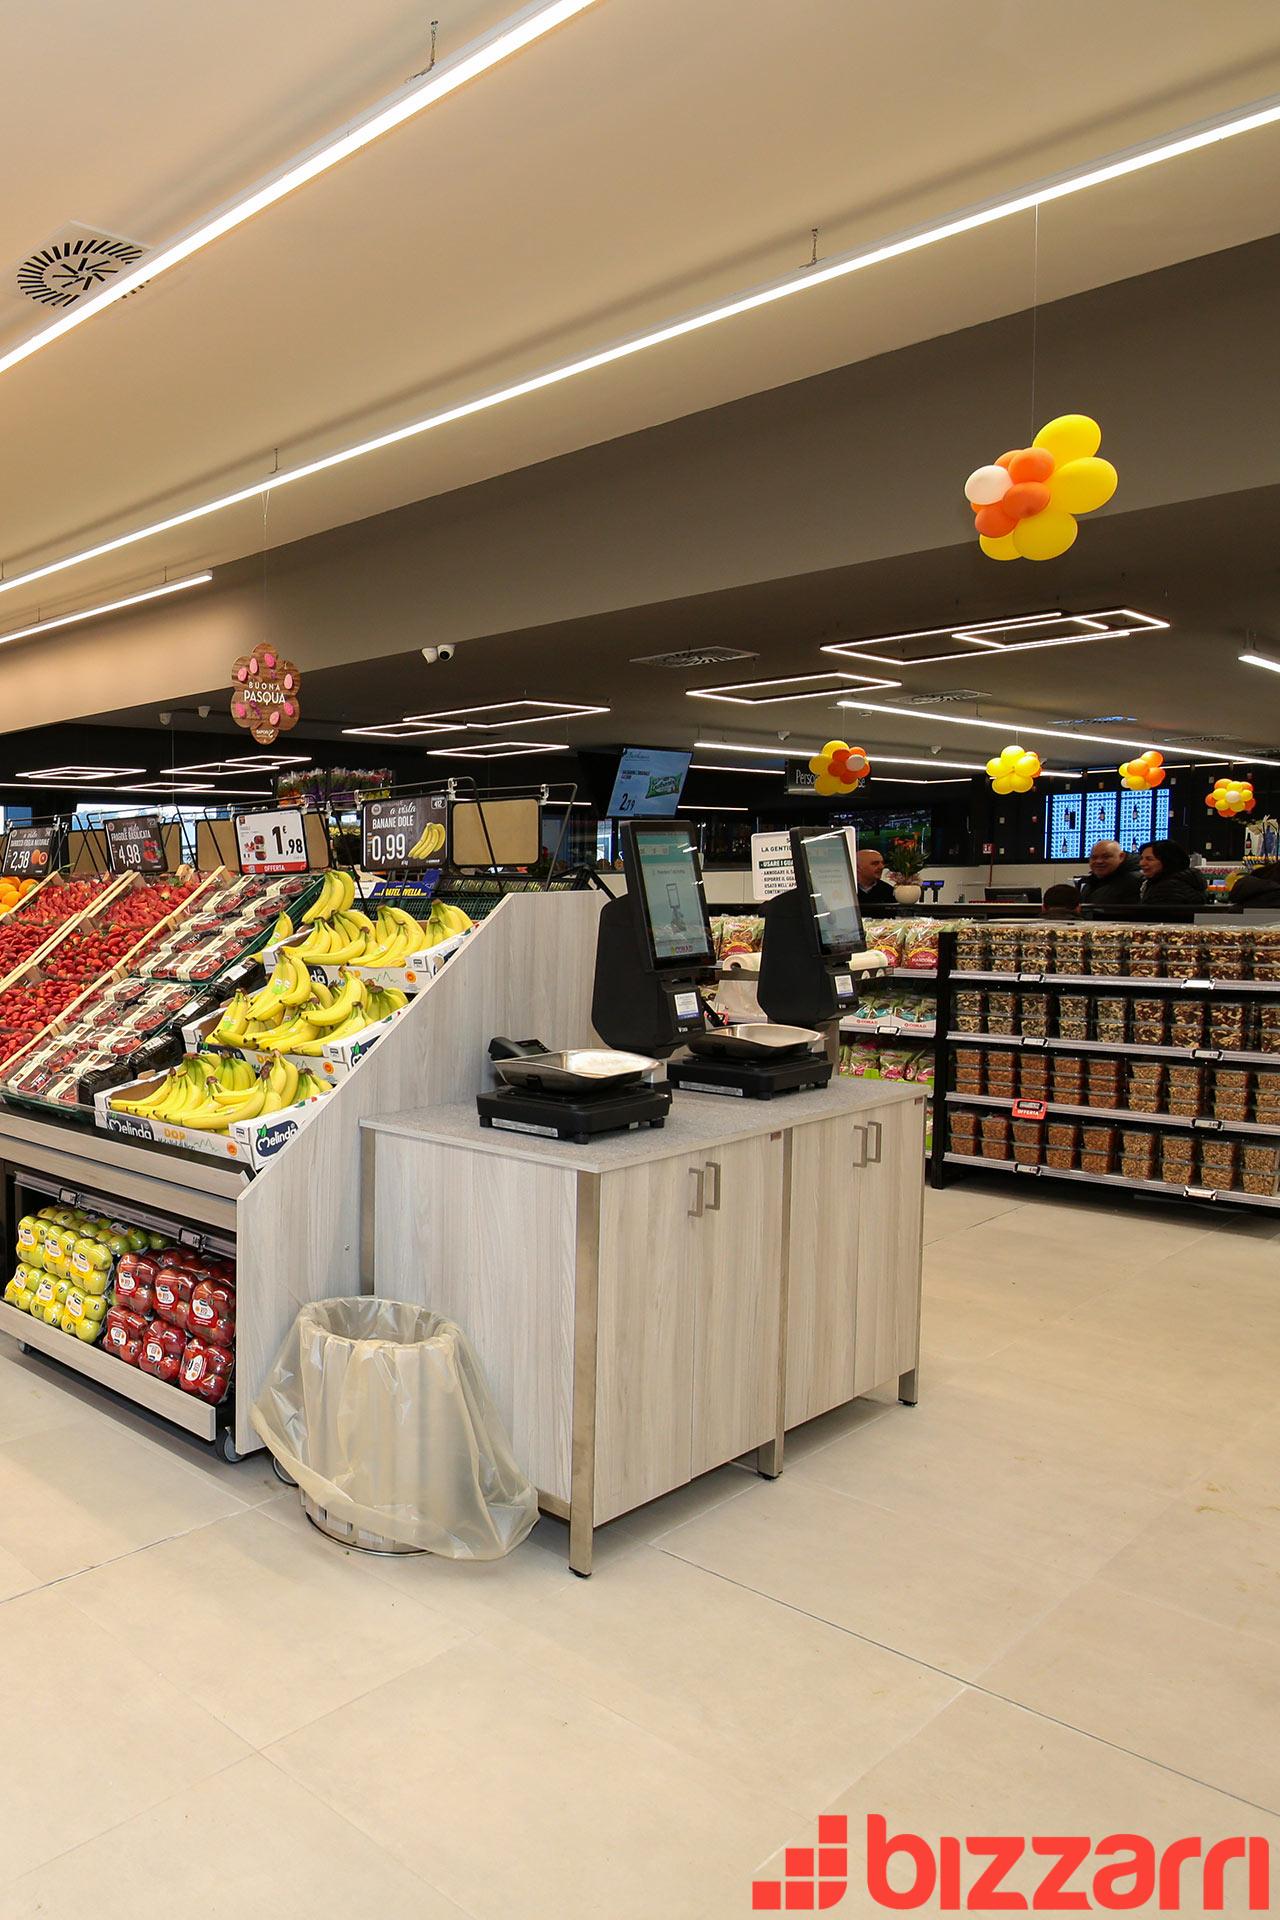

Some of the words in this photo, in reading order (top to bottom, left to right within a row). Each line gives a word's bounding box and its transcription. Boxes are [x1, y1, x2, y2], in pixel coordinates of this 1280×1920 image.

[248, 681, 280, 691] BUONA
[244, 690, 286, 705] PASQUA
[372, 816, 397, 829] BANANE
[397, 815, 414, 827] DOLE
[111, 832, 128, 841] FRAGOLE
[128, 830, 151, 840] BASILICATA
[118, 844, 142, 867] 4,98
[371, 833, 406, 865] 0,99
[10, 850, 30, 871] 2,58
[109, 1119, 152, 1140] Melinda
[257, 1125, 297, 1151] Melinda
